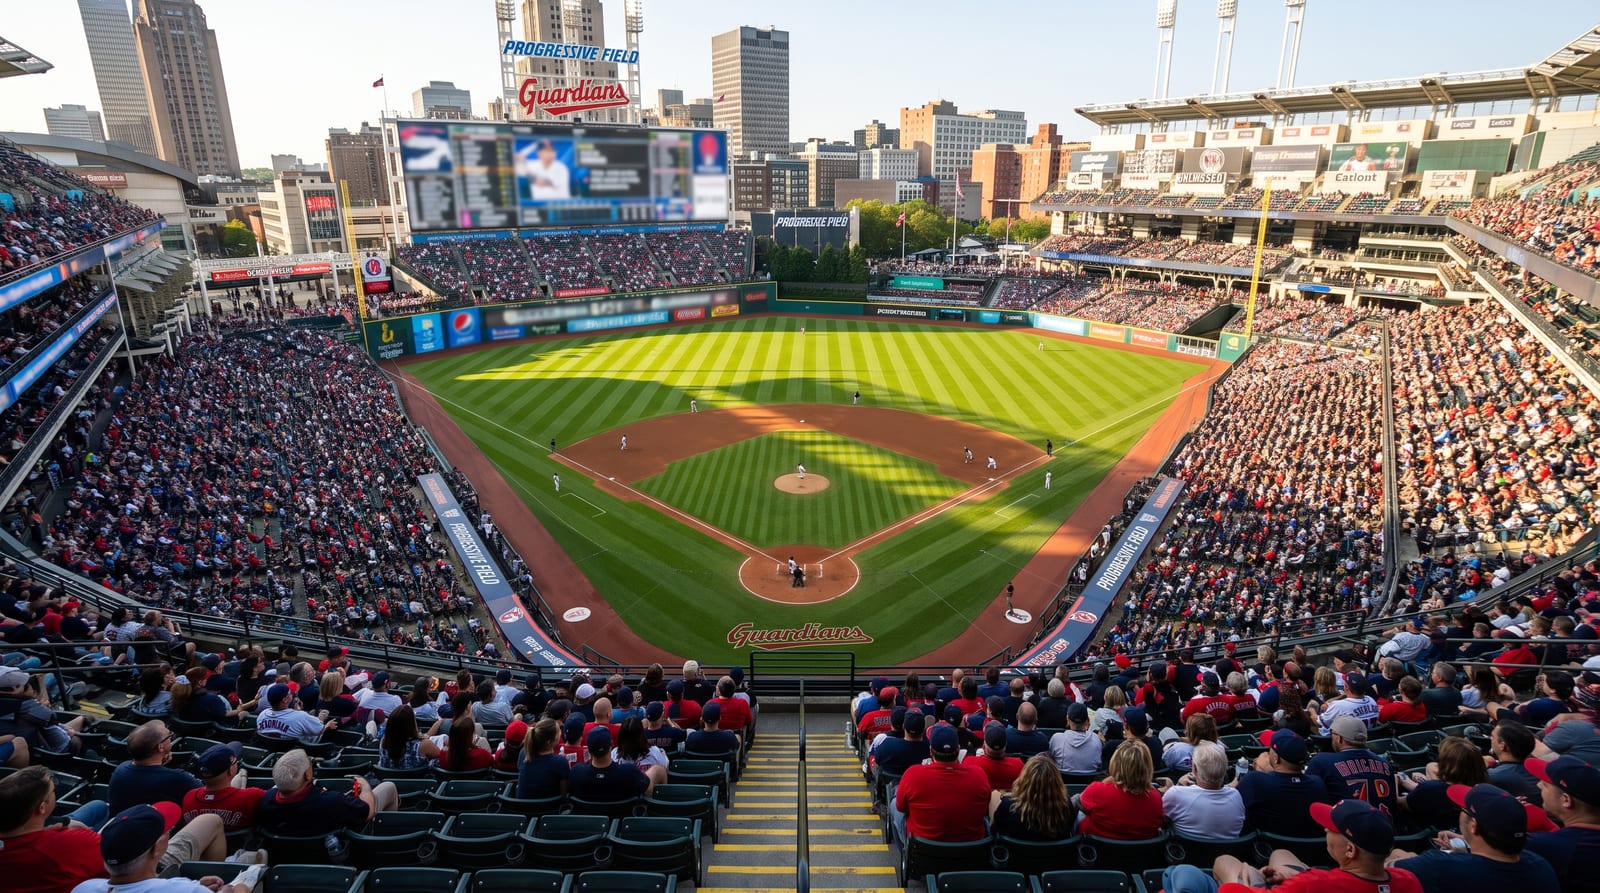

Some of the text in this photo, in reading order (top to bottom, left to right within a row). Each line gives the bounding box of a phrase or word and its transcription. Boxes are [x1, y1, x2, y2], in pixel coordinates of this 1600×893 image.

[503, 40, 640, 64] PROGRESSIVE FIELD
[519, 78, 630, 116] Guardians
[727, 622, 874, 651] Guardians
